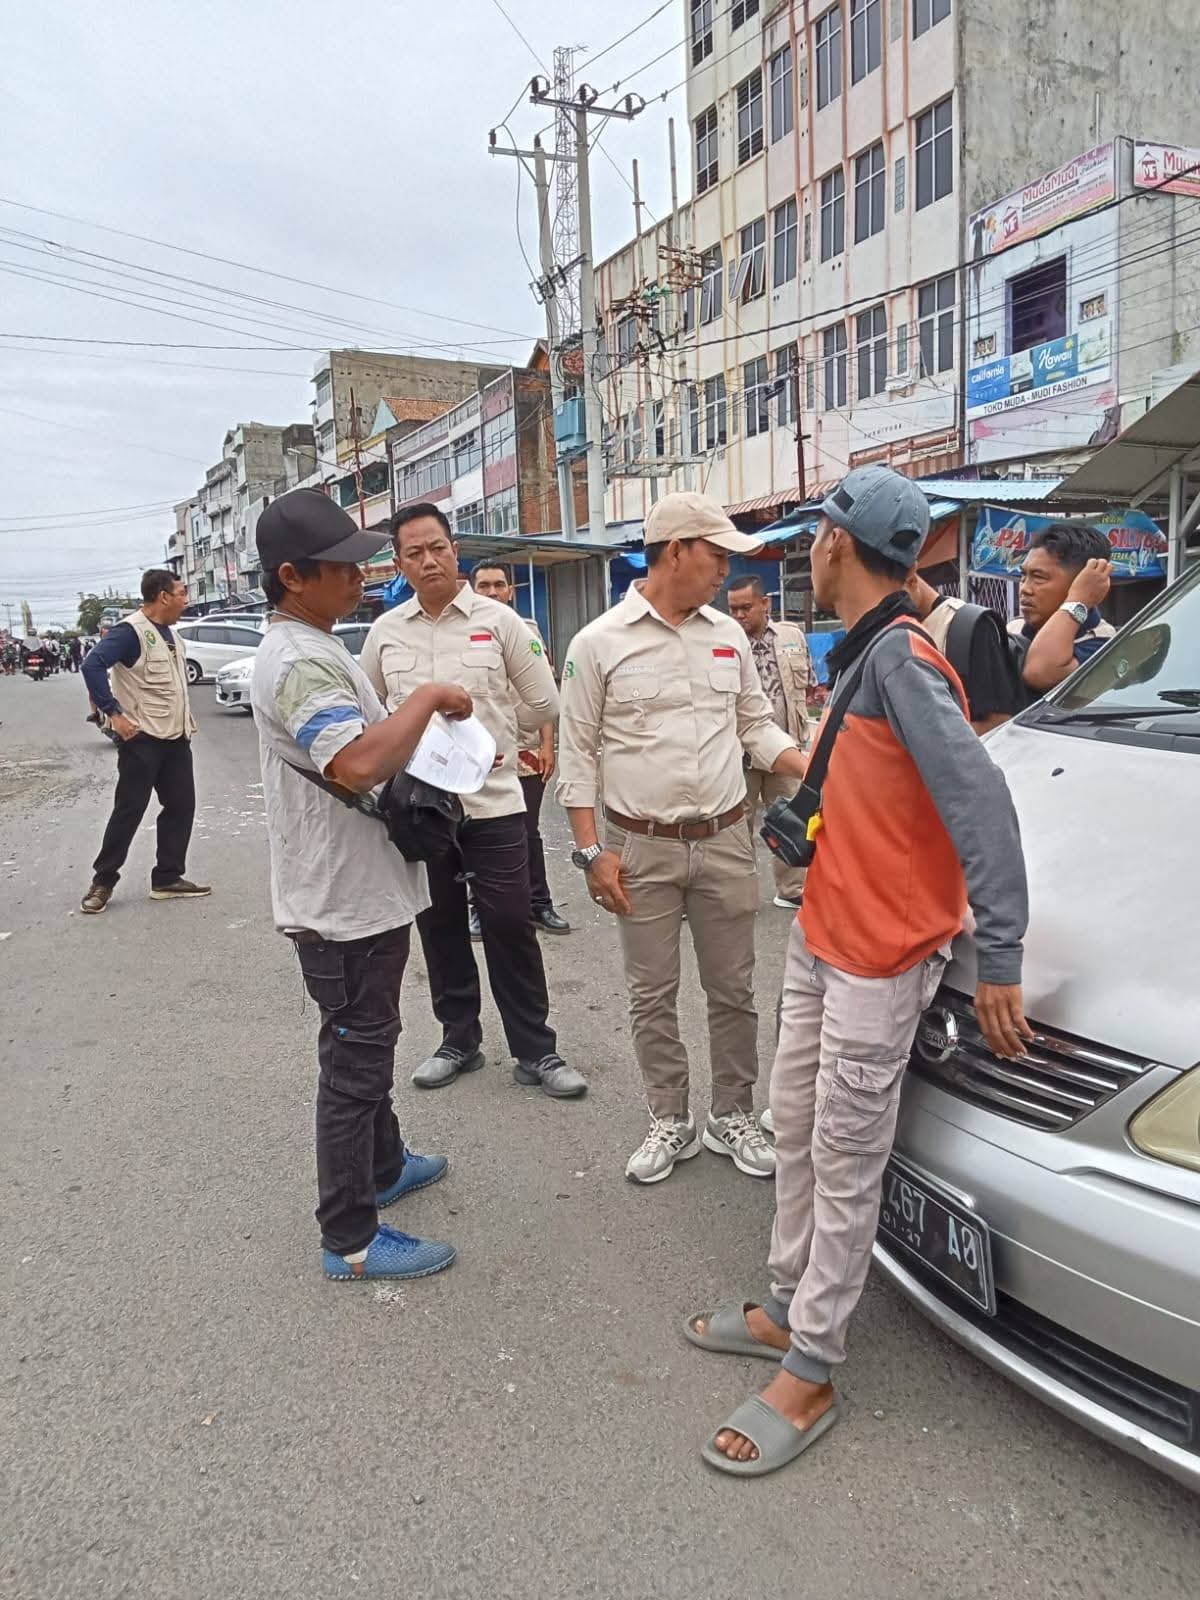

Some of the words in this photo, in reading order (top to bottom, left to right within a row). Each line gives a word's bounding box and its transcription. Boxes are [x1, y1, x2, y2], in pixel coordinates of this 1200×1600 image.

[984, 401, 1003, 414] TOKO
[1004, 394, 1026, 408] MUDA
[1031, 386, 1050, 401] MUDI
[1052, 375, 1087, 395] FASHION
